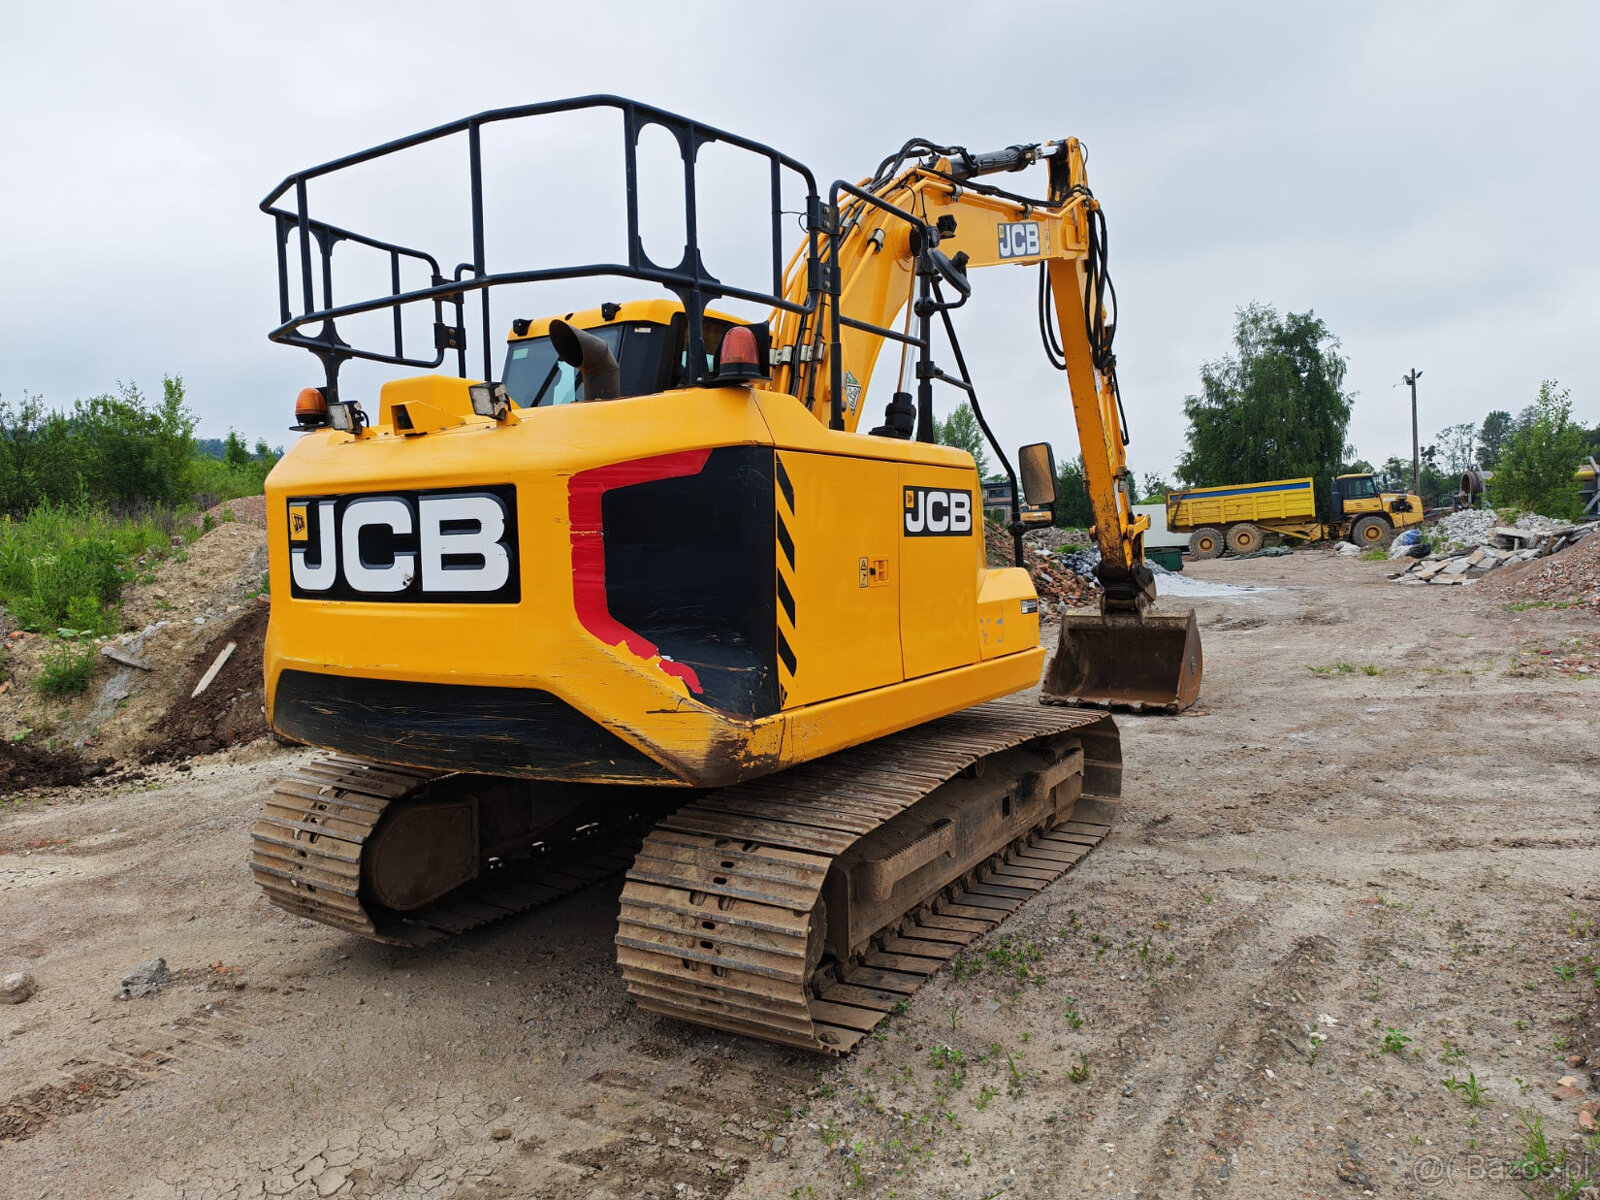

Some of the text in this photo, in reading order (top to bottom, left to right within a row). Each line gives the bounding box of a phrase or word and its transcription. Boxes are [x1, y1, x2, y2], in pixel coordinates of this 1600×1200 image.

[1000, 223, 1039, 256] JCB
[905, 491, 971, 532] JCB
[288, 494, 512, 592] JCB
